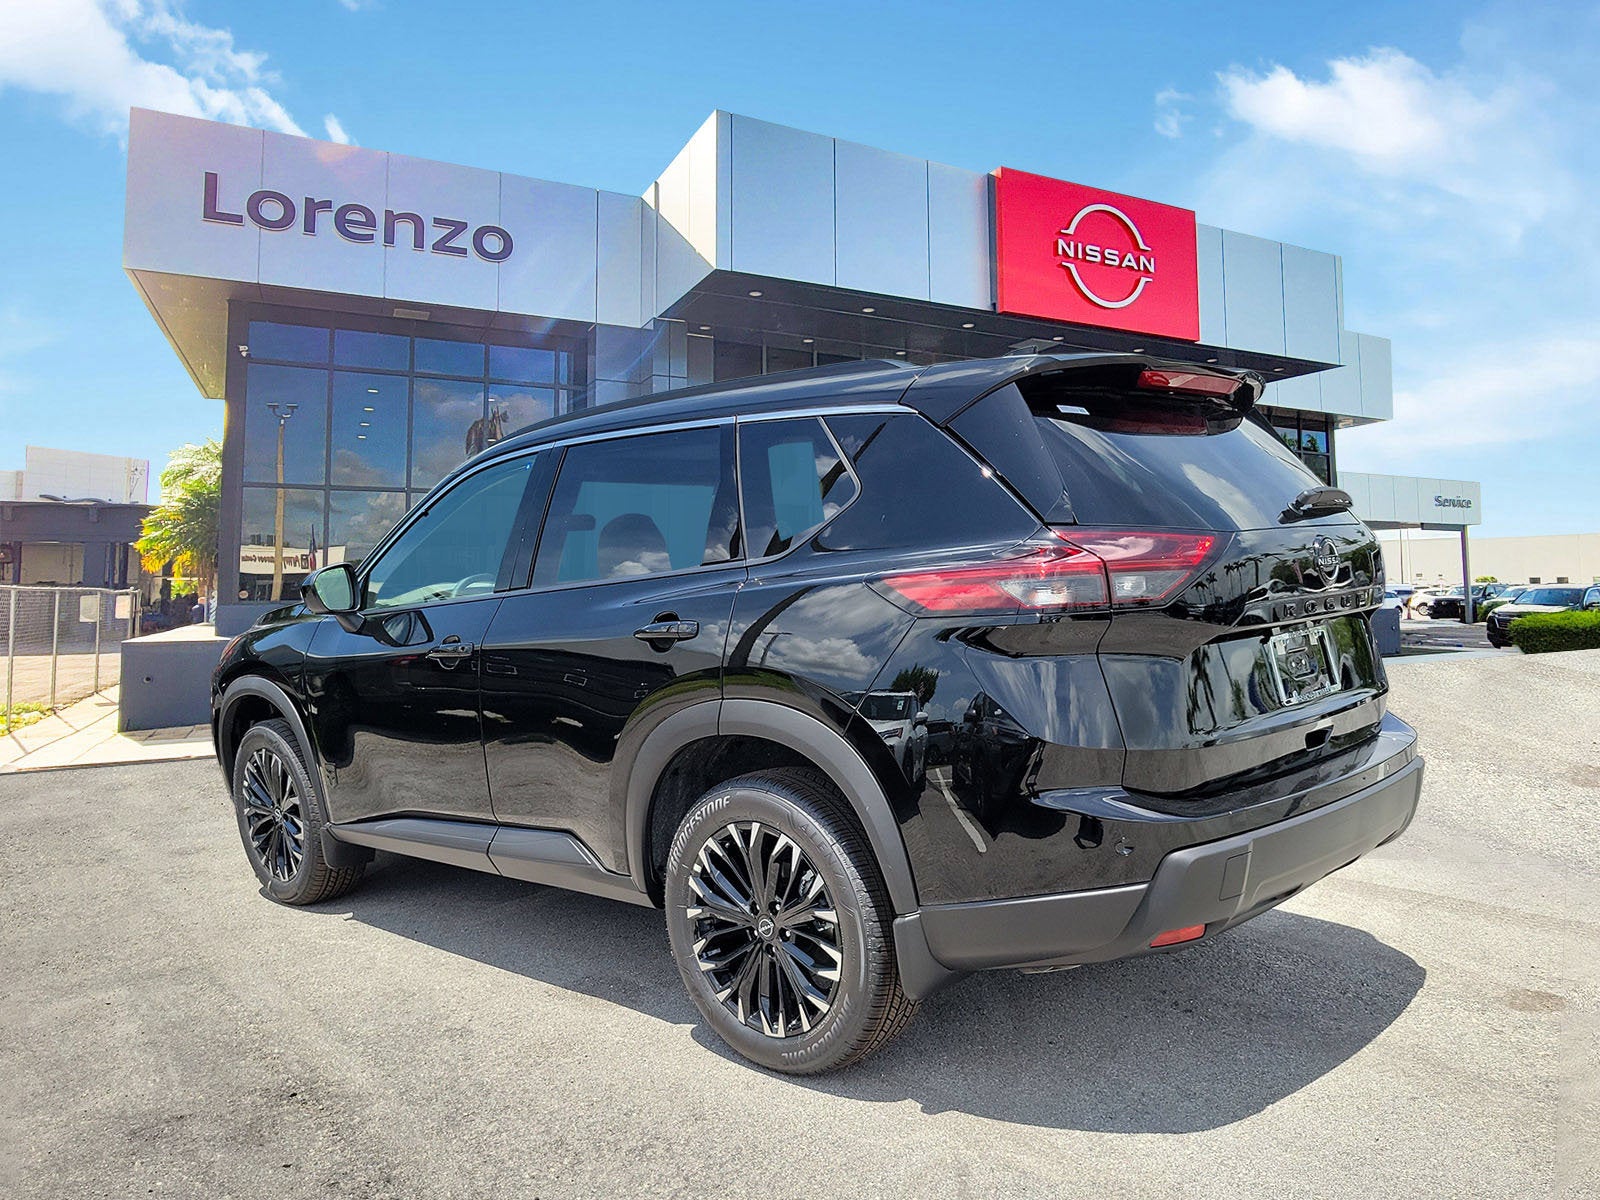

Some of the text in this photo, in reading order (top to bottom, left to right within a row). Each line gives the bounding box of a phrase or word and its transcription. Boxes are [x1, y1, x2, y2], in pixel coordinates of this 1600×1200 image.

[203, 171, 514, 262] Lorenzo
[1057, 238, 1155, 273] NISSAN
[1434, 495, 1472, 508] Service
[669, 795, 731, 876] BRIDGESTONE
